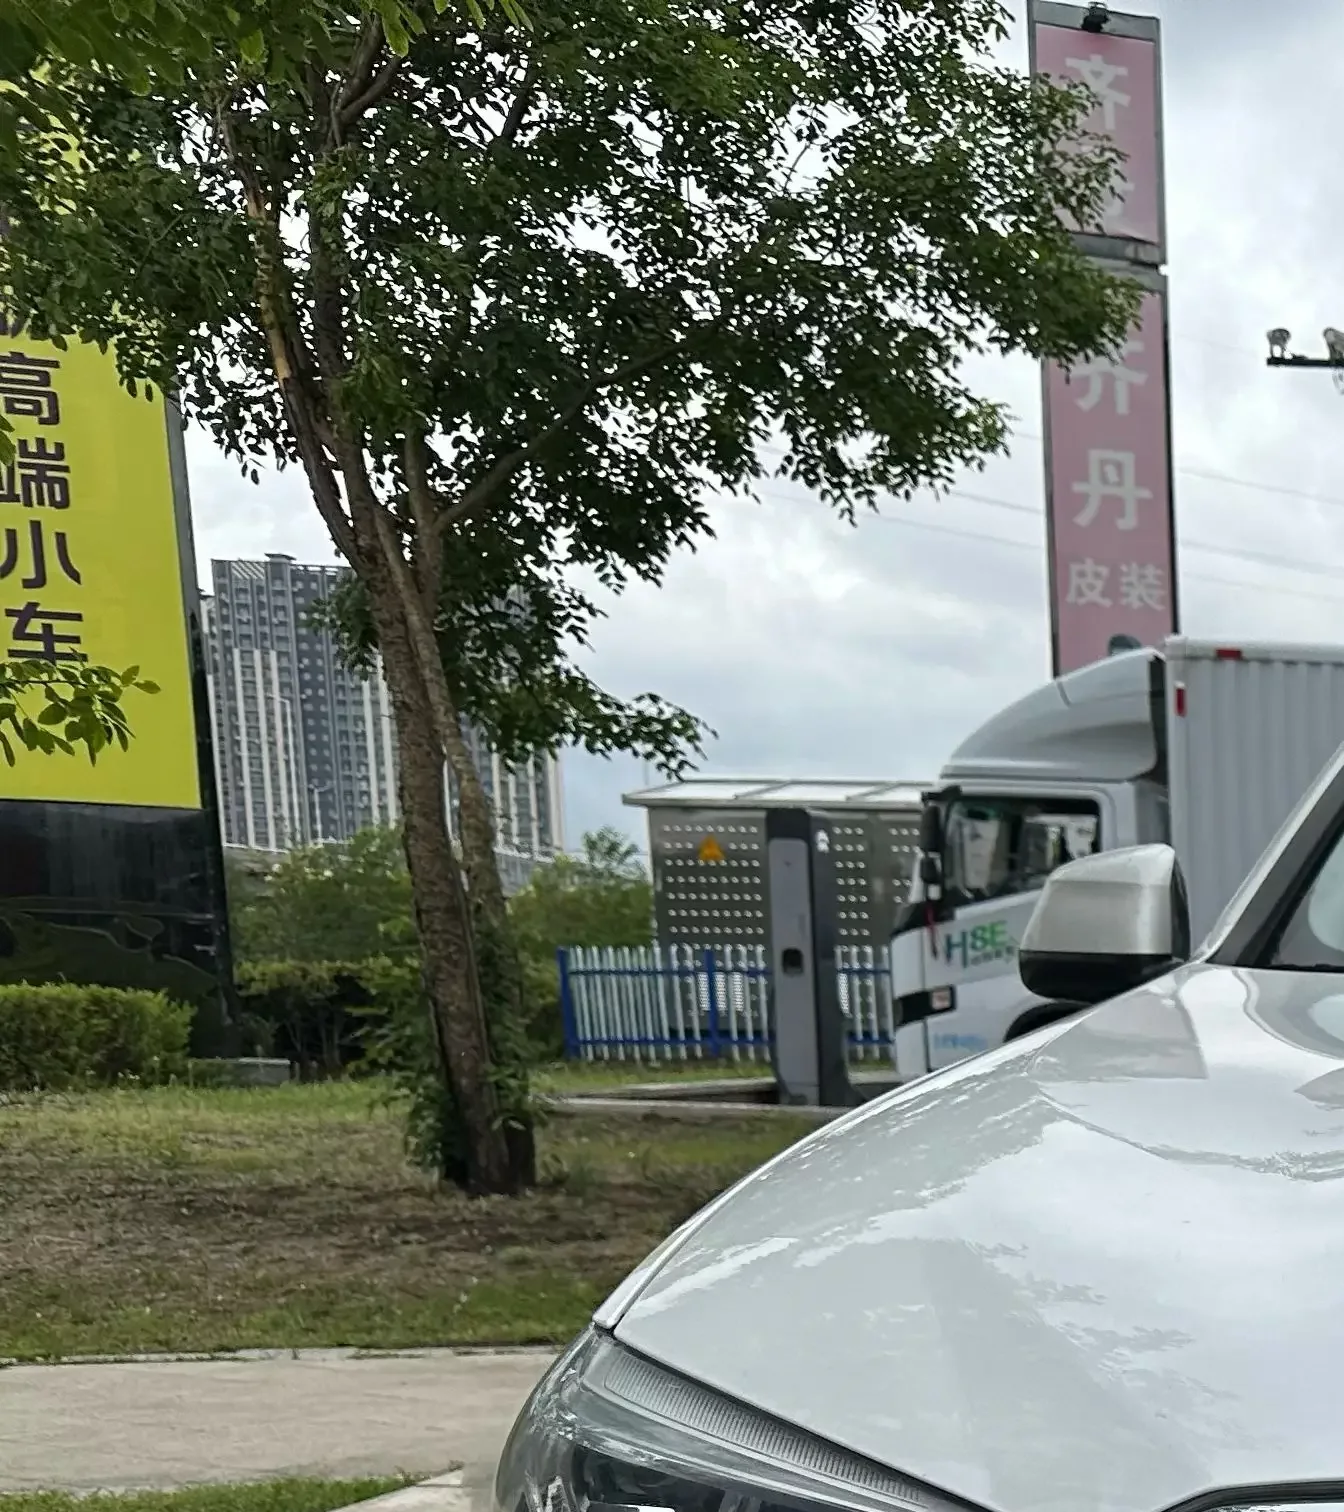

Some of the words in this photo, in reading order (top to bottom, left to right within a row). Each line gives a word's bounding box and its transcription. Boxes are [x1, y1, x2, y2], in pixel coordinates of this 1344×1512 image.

[0, 302, 88, 668] 高端小车
[1065, 558, 1165, 611] 皮装
